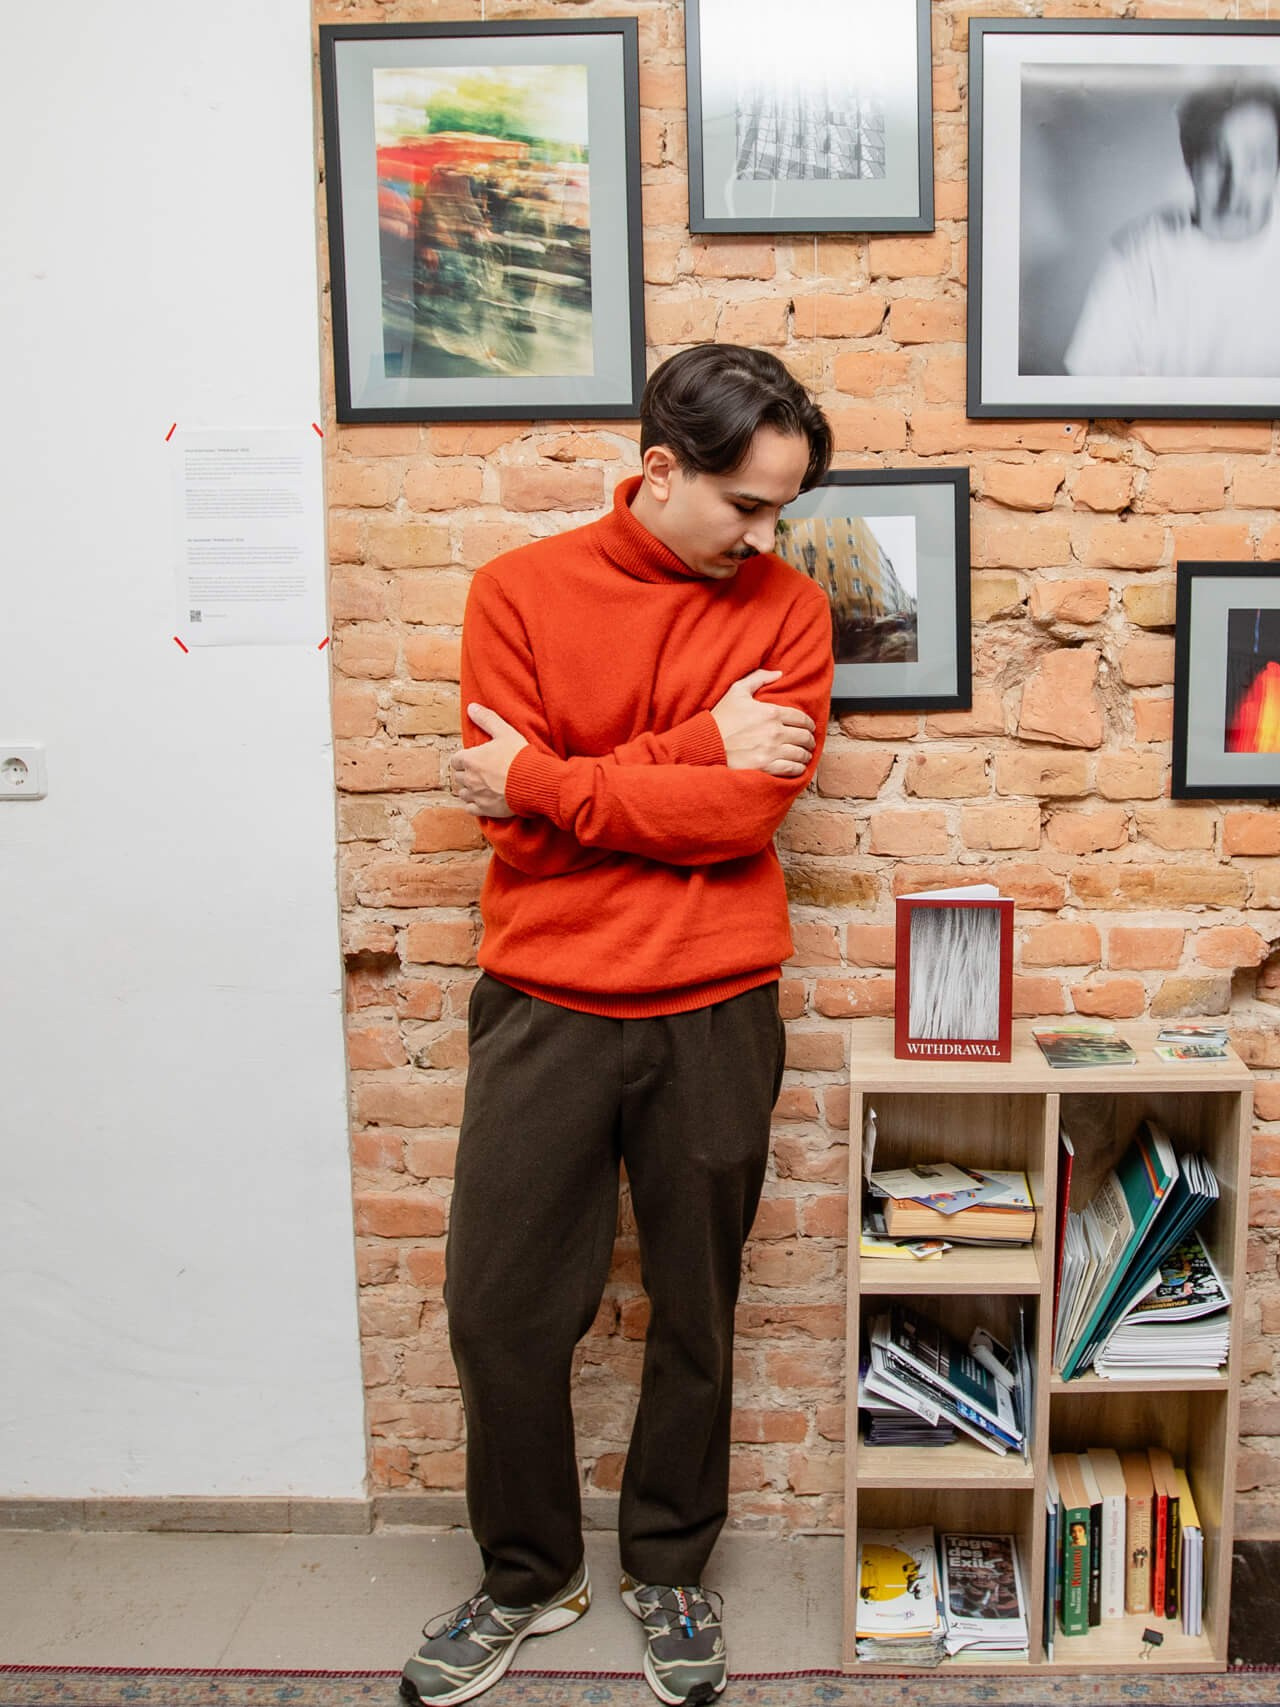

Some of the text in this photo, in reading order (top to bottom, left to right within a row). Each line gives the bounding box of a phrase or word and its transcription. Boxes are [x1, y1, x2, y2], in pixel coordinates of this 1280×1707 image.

[906, 1043, 1001, 1057] WITHDRAWAL
[947, 1536, 993, 1549] Tage
[948, 1547, 983, 1558] des
[949, 1557, 996, 1569] Exils
